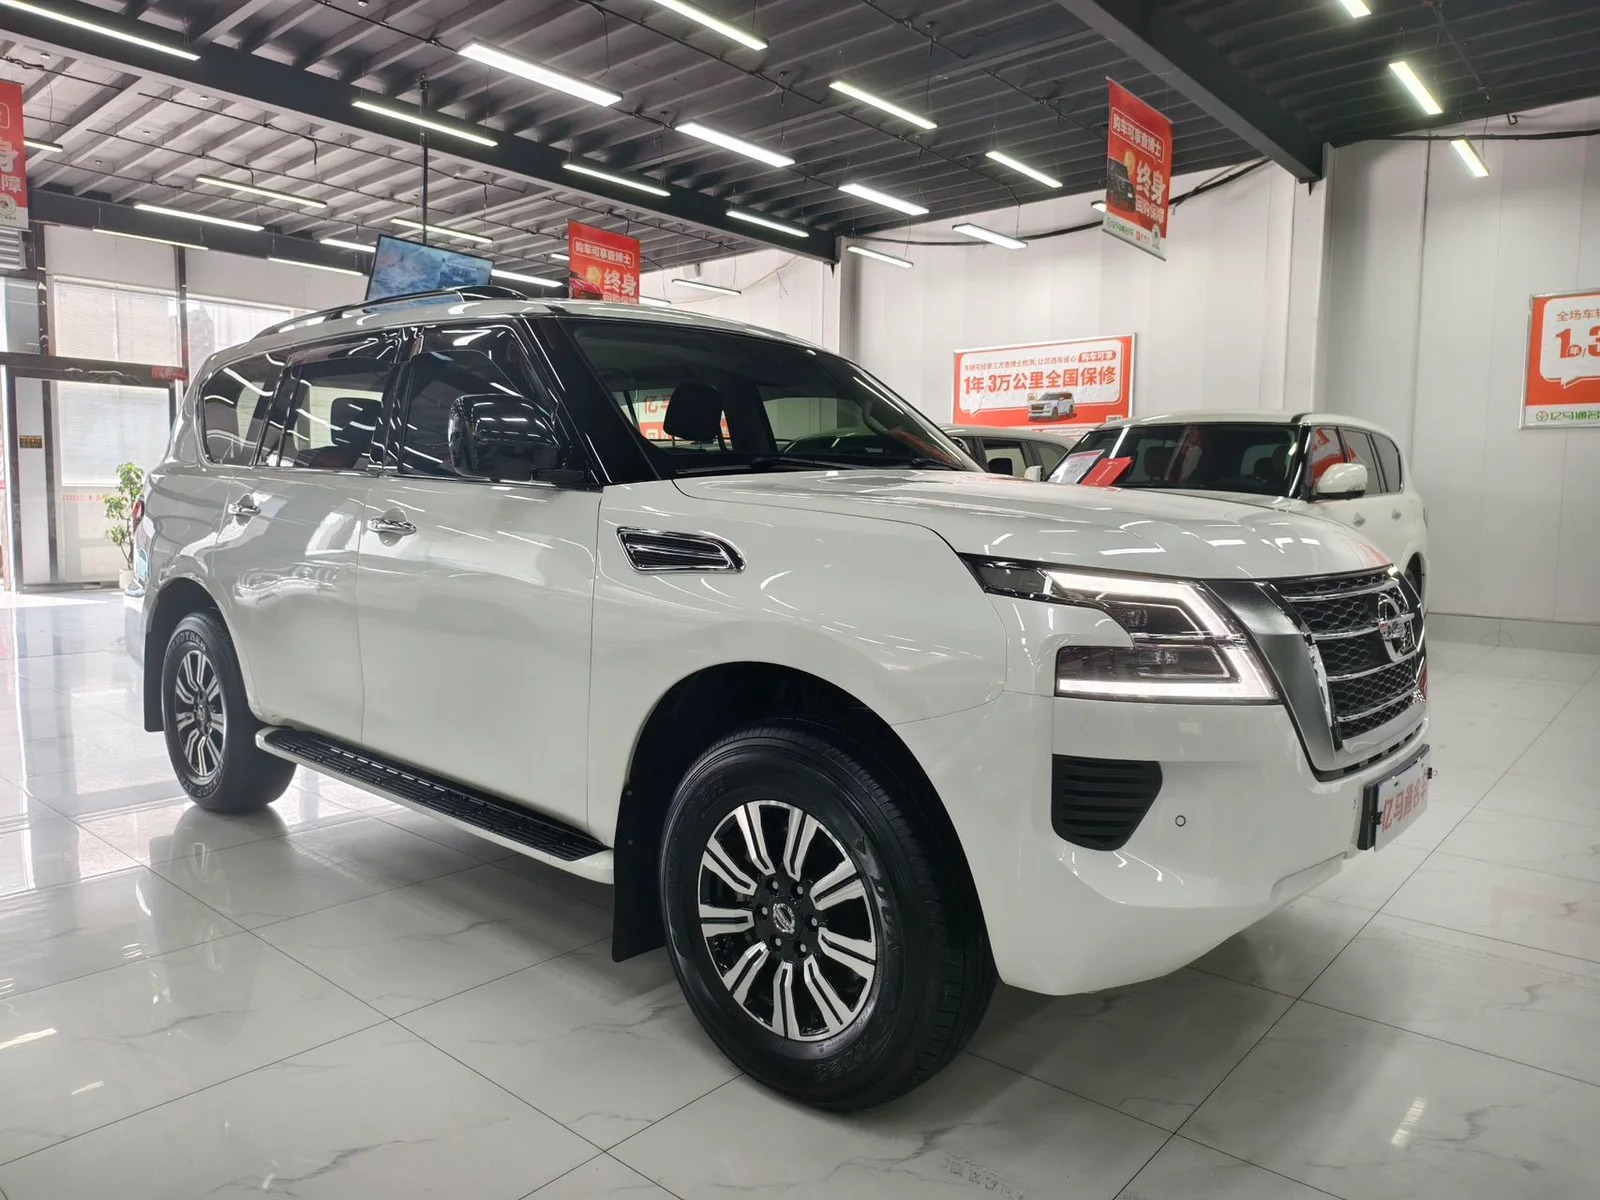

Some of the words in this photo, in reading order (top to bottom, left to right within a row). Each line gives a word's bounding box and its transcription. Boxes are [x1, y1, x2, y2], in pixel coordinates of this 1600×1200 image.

[1136, 160, 1166, 205] 终身
[604, 268, 637, 297] 终身
[963, 366, 1116, 394] 1年3万公里全国保修
